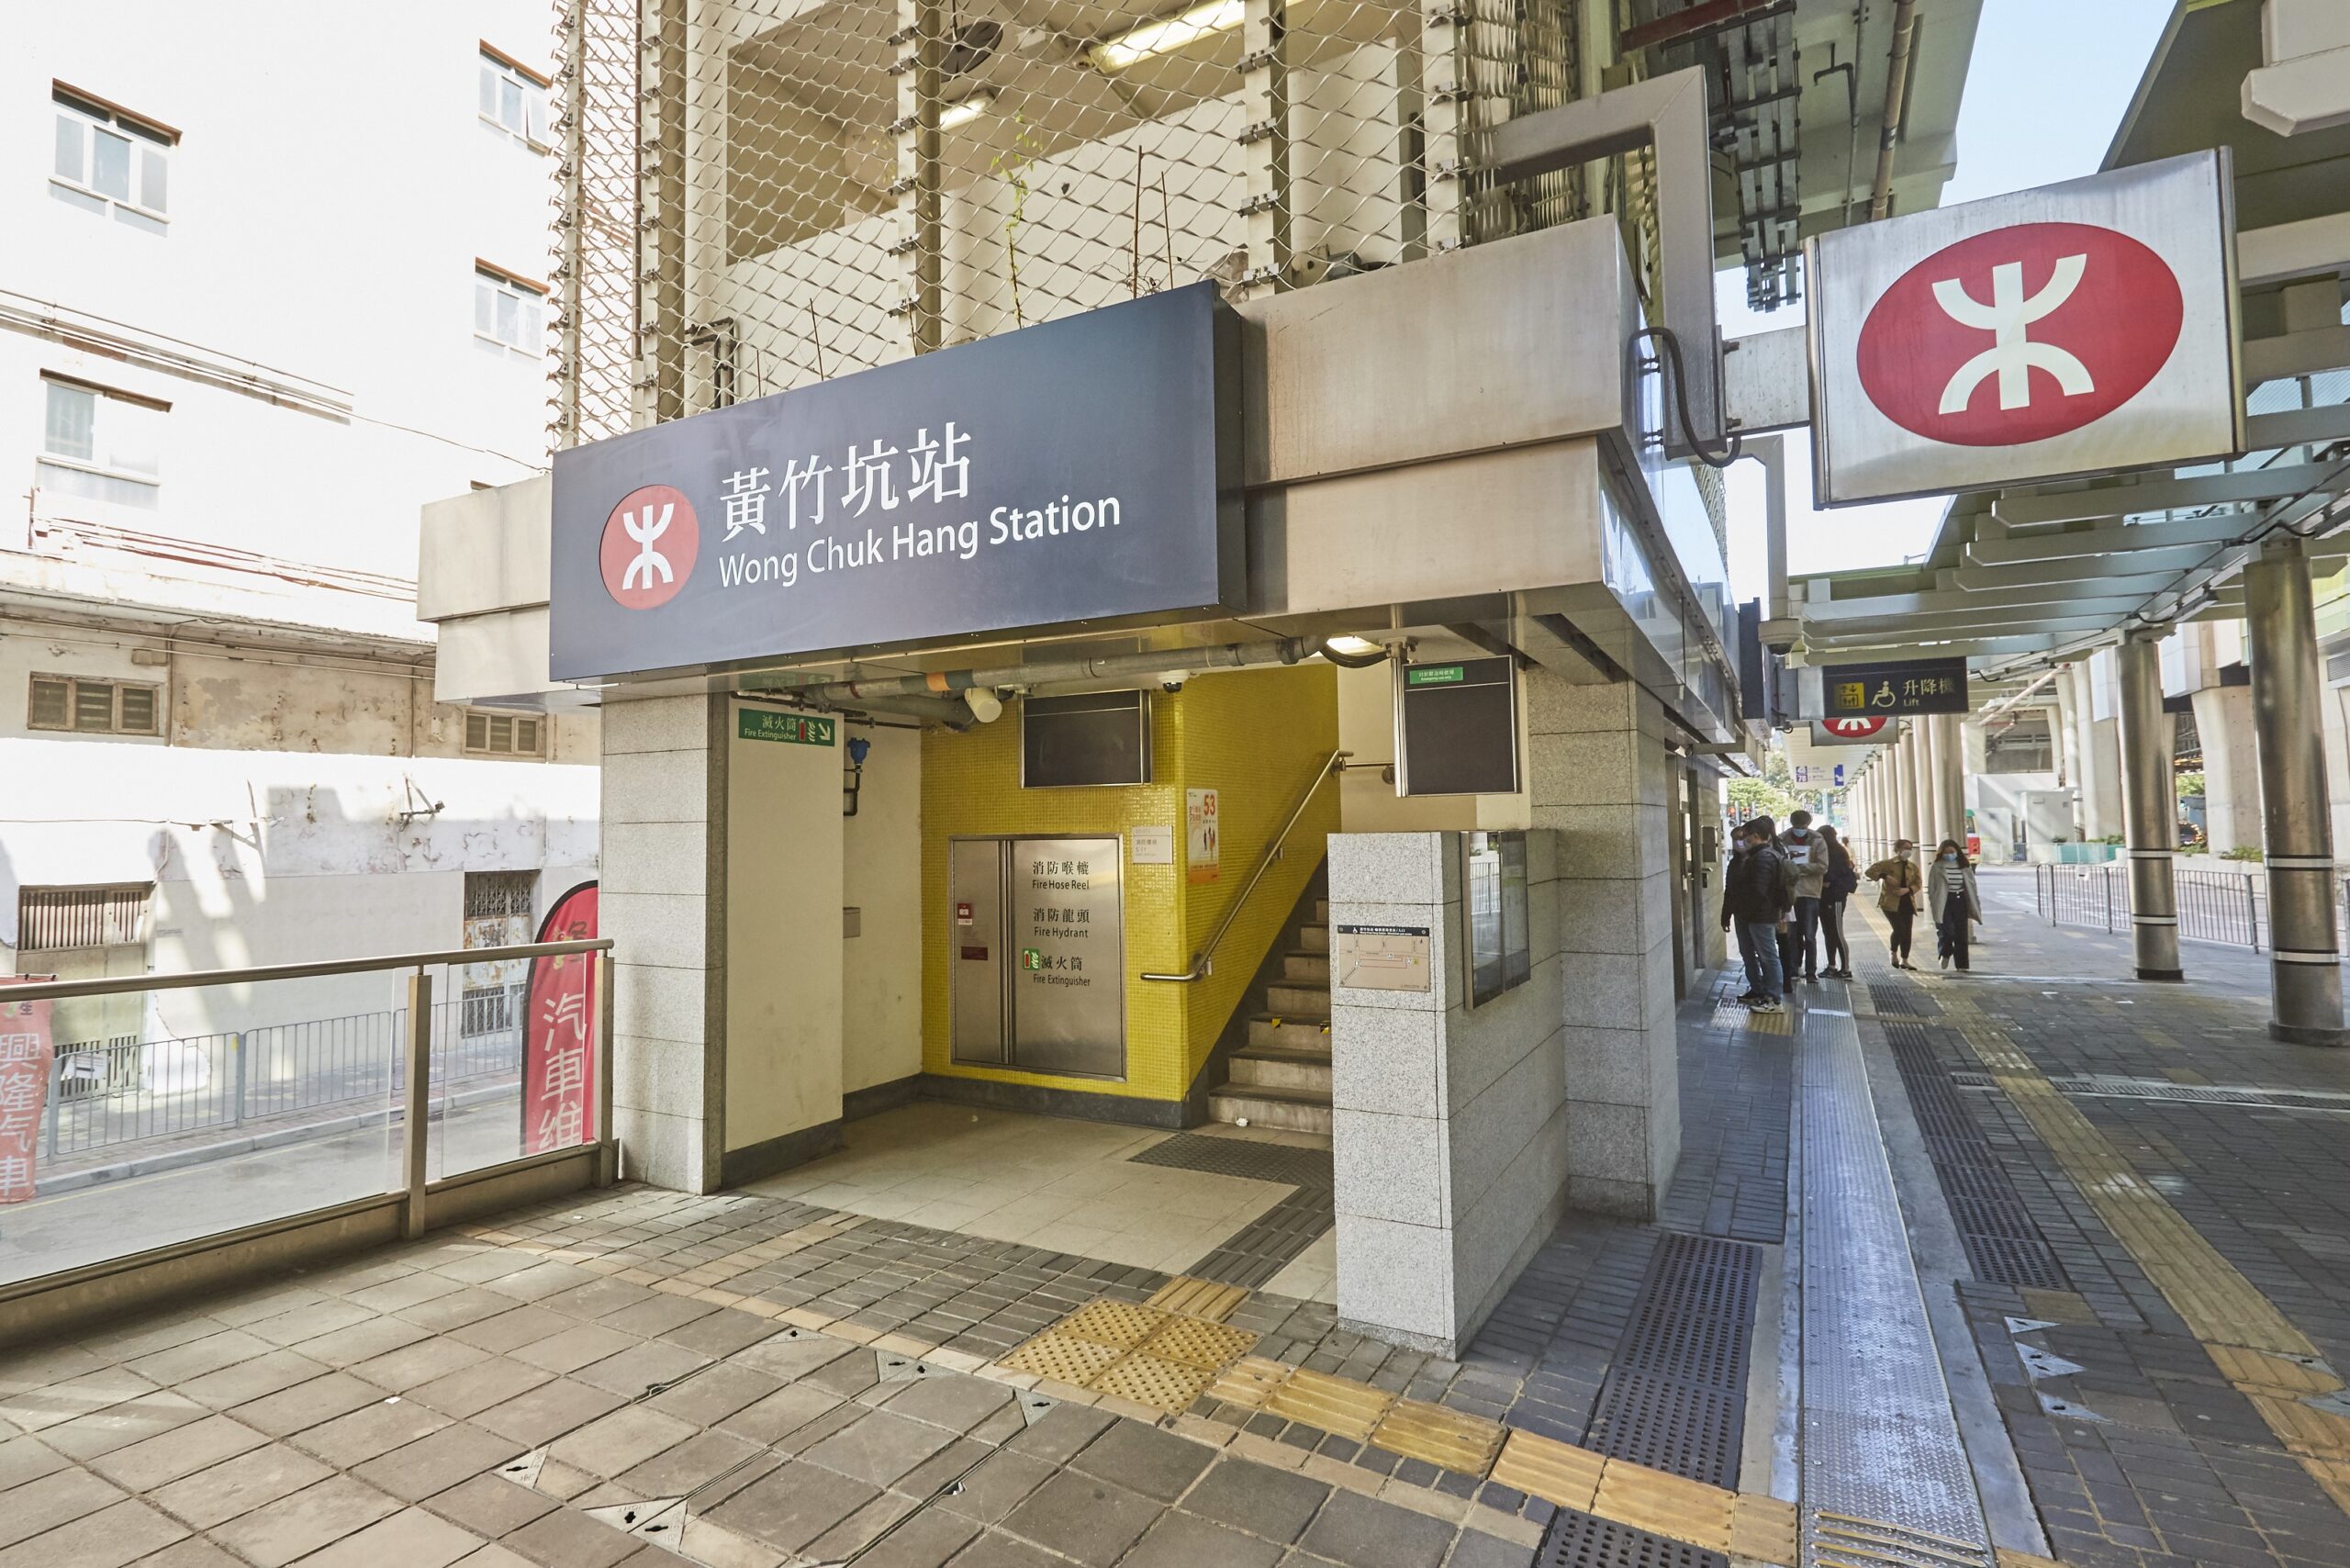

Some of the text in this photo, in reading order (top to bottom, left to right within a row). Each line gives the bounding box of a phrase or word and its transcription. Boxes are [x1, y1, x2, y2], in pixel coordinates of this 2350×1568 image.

[720, 421, 971, 543] 黃竹坑站
[719, 495, 1120, 588] Wong Chuk Hang Station
[1903, 698, 1919, 706] Lift
[763, 715, 796, 732] 滅火筒
[744, 727, 797, 741] Fire Extinguisher
[1203, 794, 1216, 815] 53
[1033, 861, 1090, 875] 消防喉轆
[1032, 879, 1090, 890] Fire Hose Reel
[1034, 907, 1090, 924] 消防龍頭
[1034, 926, 1089, 939] Fire Hydrant
[1041, 956, 1082, 971] 滅火筒
[1034, 974, 1091, 988] Fire Extinguisher
